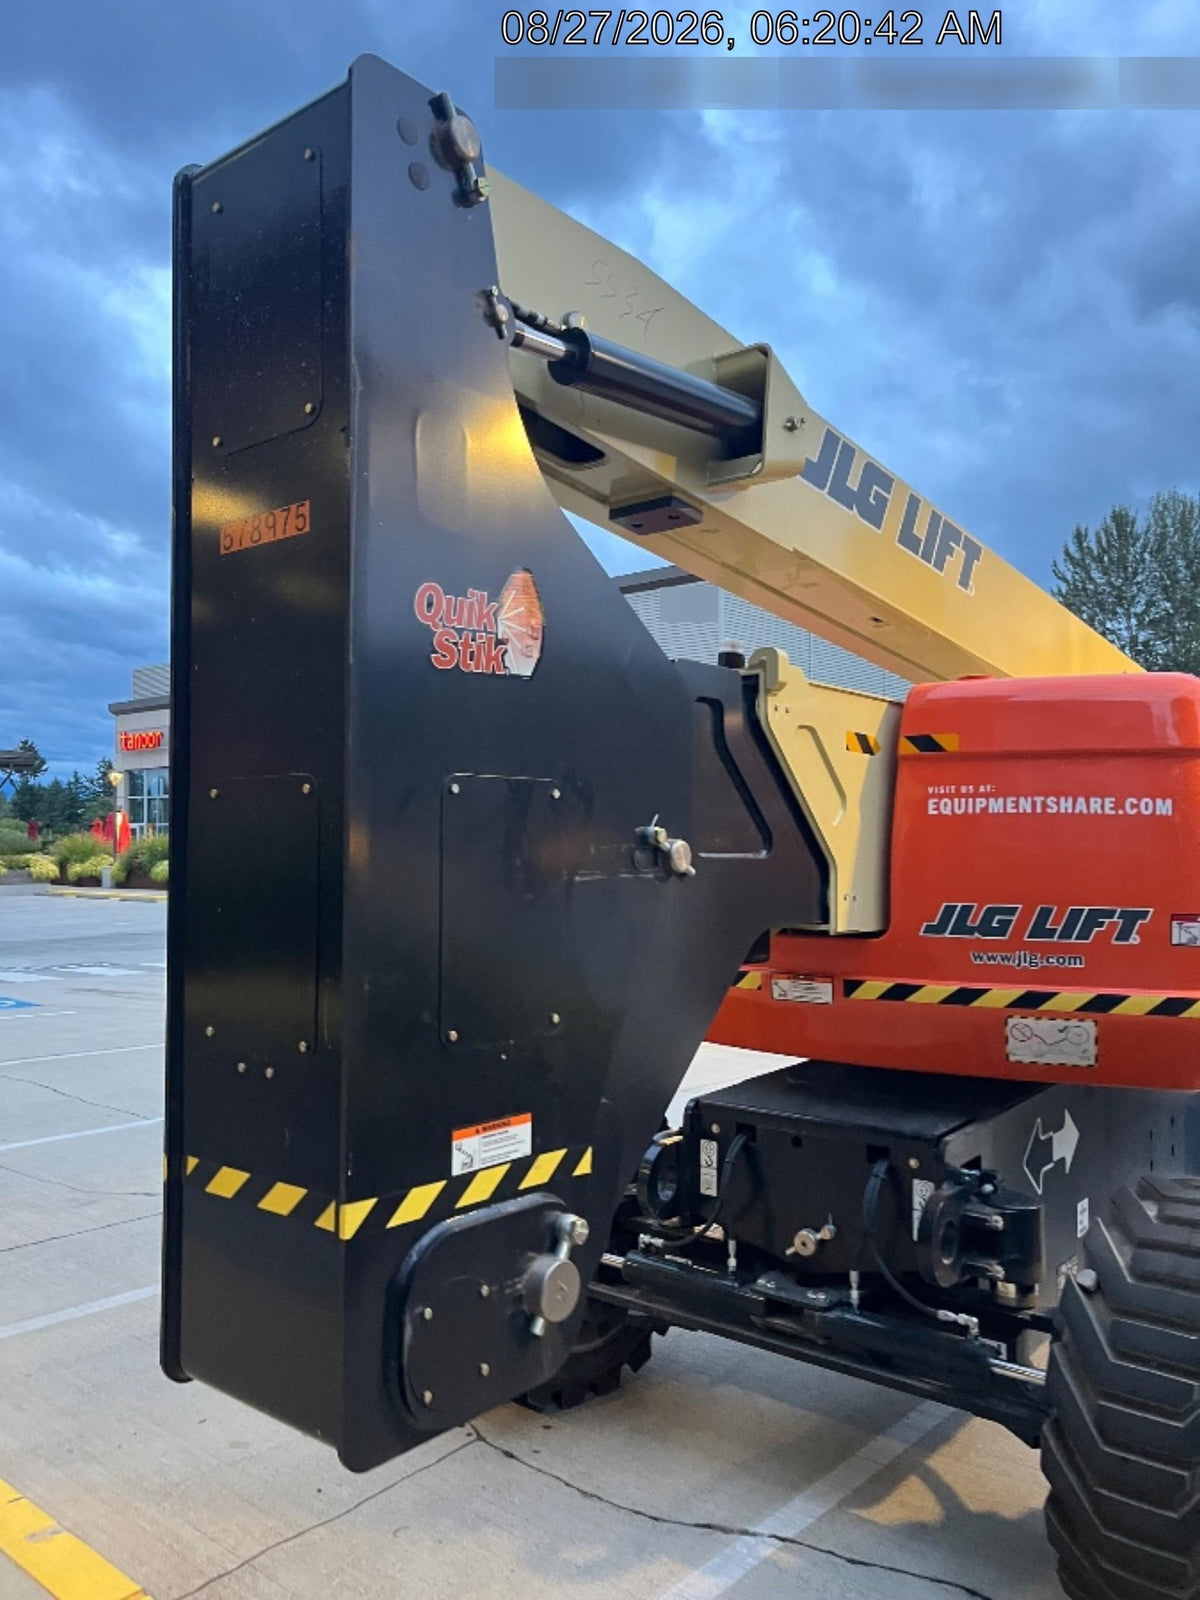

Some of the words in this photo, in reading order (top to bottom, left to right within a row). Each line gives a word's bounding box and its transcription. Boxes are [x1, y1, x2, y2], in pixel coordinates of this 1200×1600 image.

[799, 427, 896, 533] JLG
[897, 490, 984, 596] LIFT
[414, 582, 499, 633] Quik
[430, 628, 506, 674] Stik
[927, 785, 956, 794] VISIT
[960, 785, 975, 793] US
[979, 784, 997, 793] AT:
[927, 796, 1173, 816] EQUIPMENTSHARE.COM
[919, 902, 1022, 939] JLG
[1024, 905, 1154, 944] LIFT
[971, 950, 1085, 968] www.jlg.com
